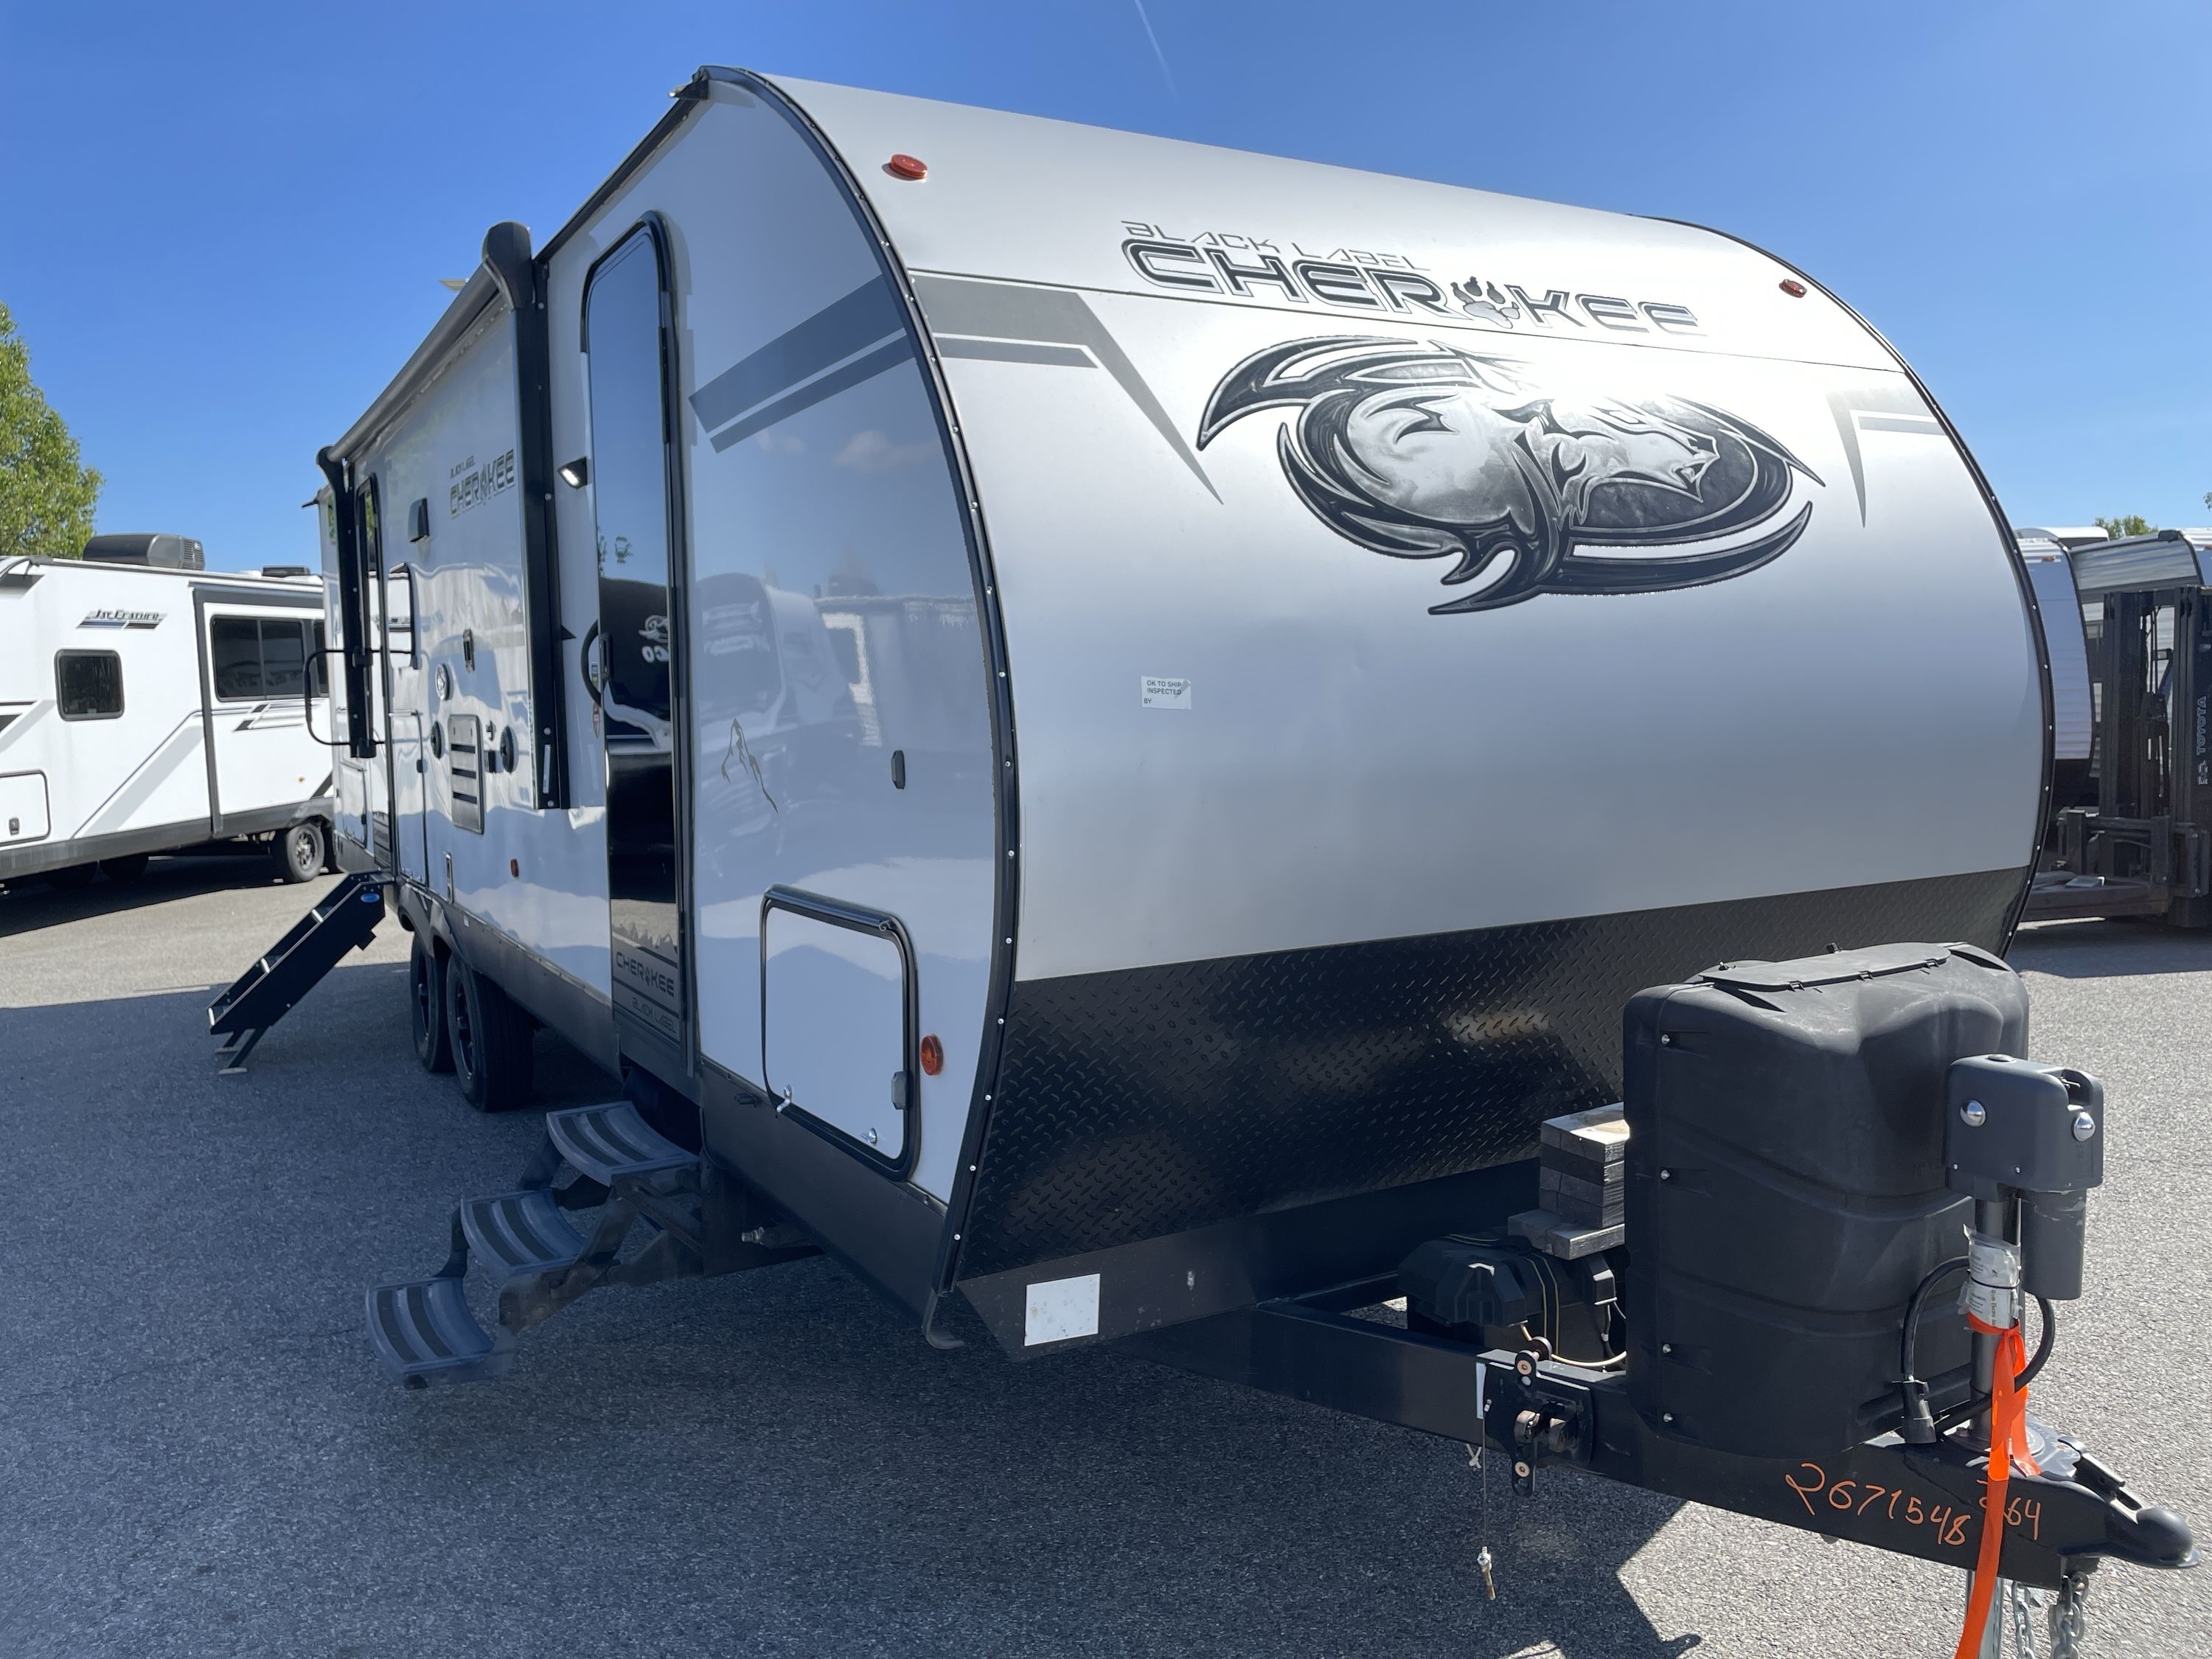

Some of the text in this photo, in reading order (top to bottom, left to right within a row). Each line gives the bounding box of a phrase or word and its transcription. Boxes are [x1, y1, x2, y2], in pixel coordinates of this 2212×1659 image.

[1120, 220, 1430, 271] BLACK LABEL
[1147, 687, 1182, 695] INSPECTED
[2197, 695, 2207, 756] TOYOTA
